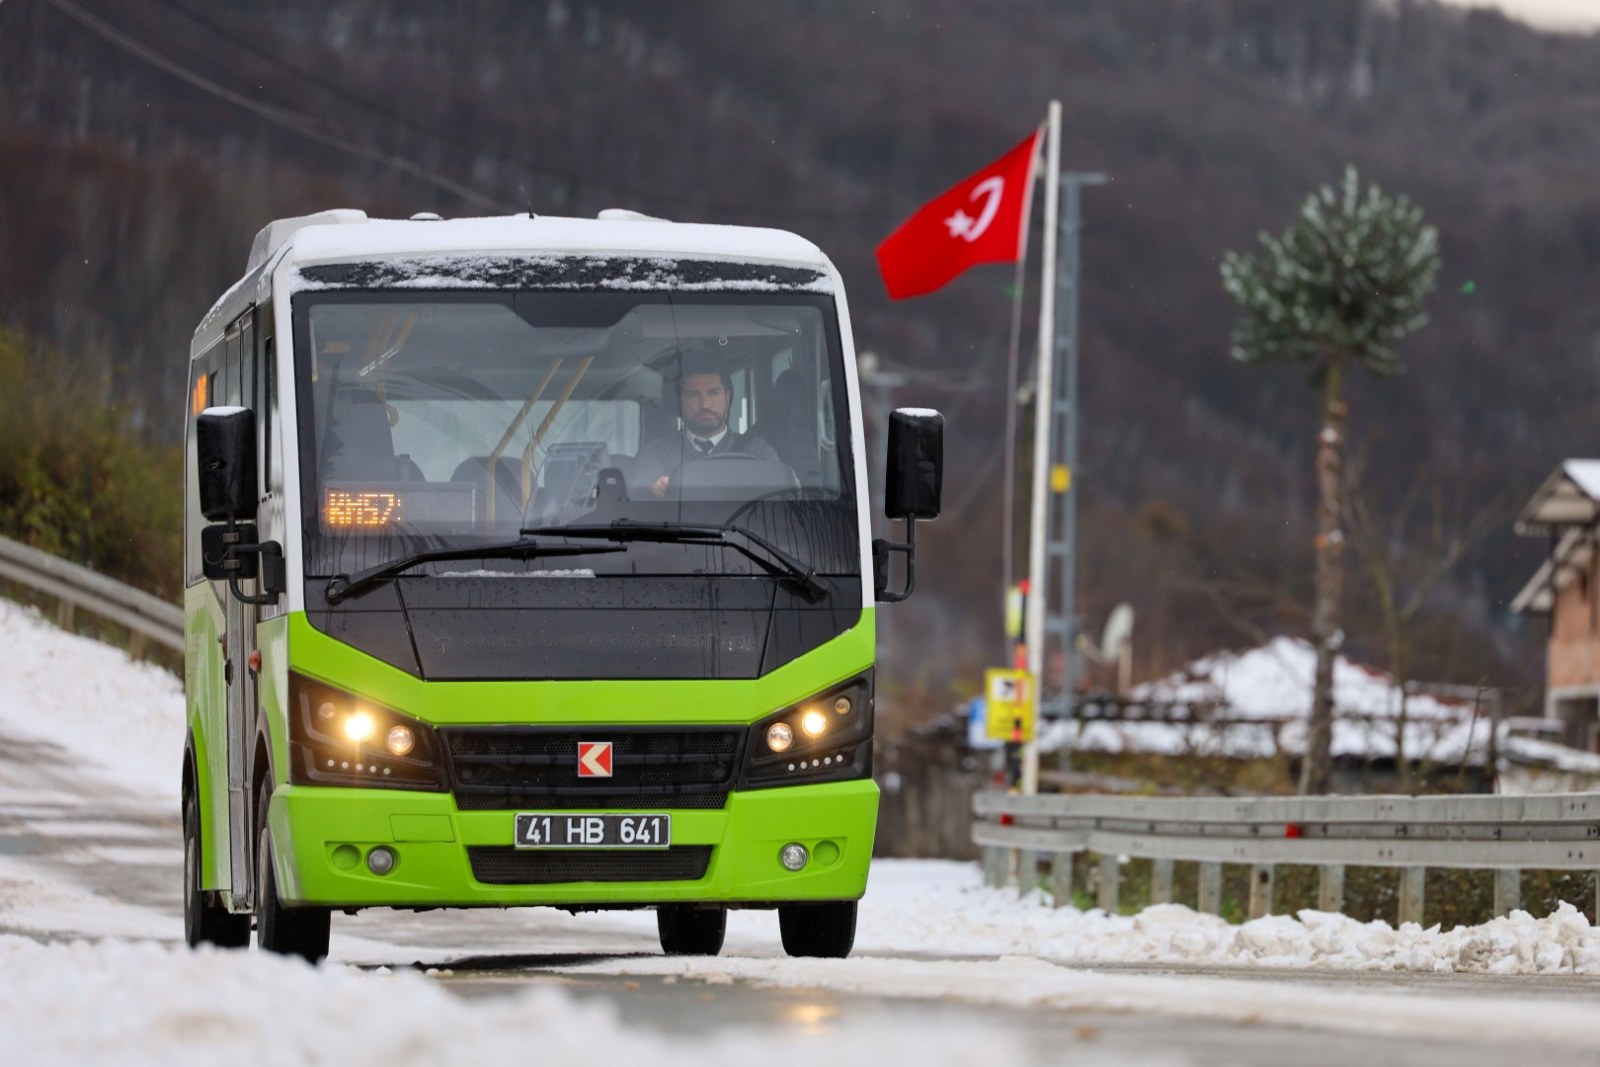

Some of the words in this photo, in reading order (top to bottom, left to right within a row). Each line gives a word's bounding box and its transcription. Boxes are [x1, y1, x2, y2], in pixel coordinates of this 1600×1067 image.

[525, 817, 551, 843] 41
[566, 817, 605, 843] HB
[620, 817, 660, 843] 641
